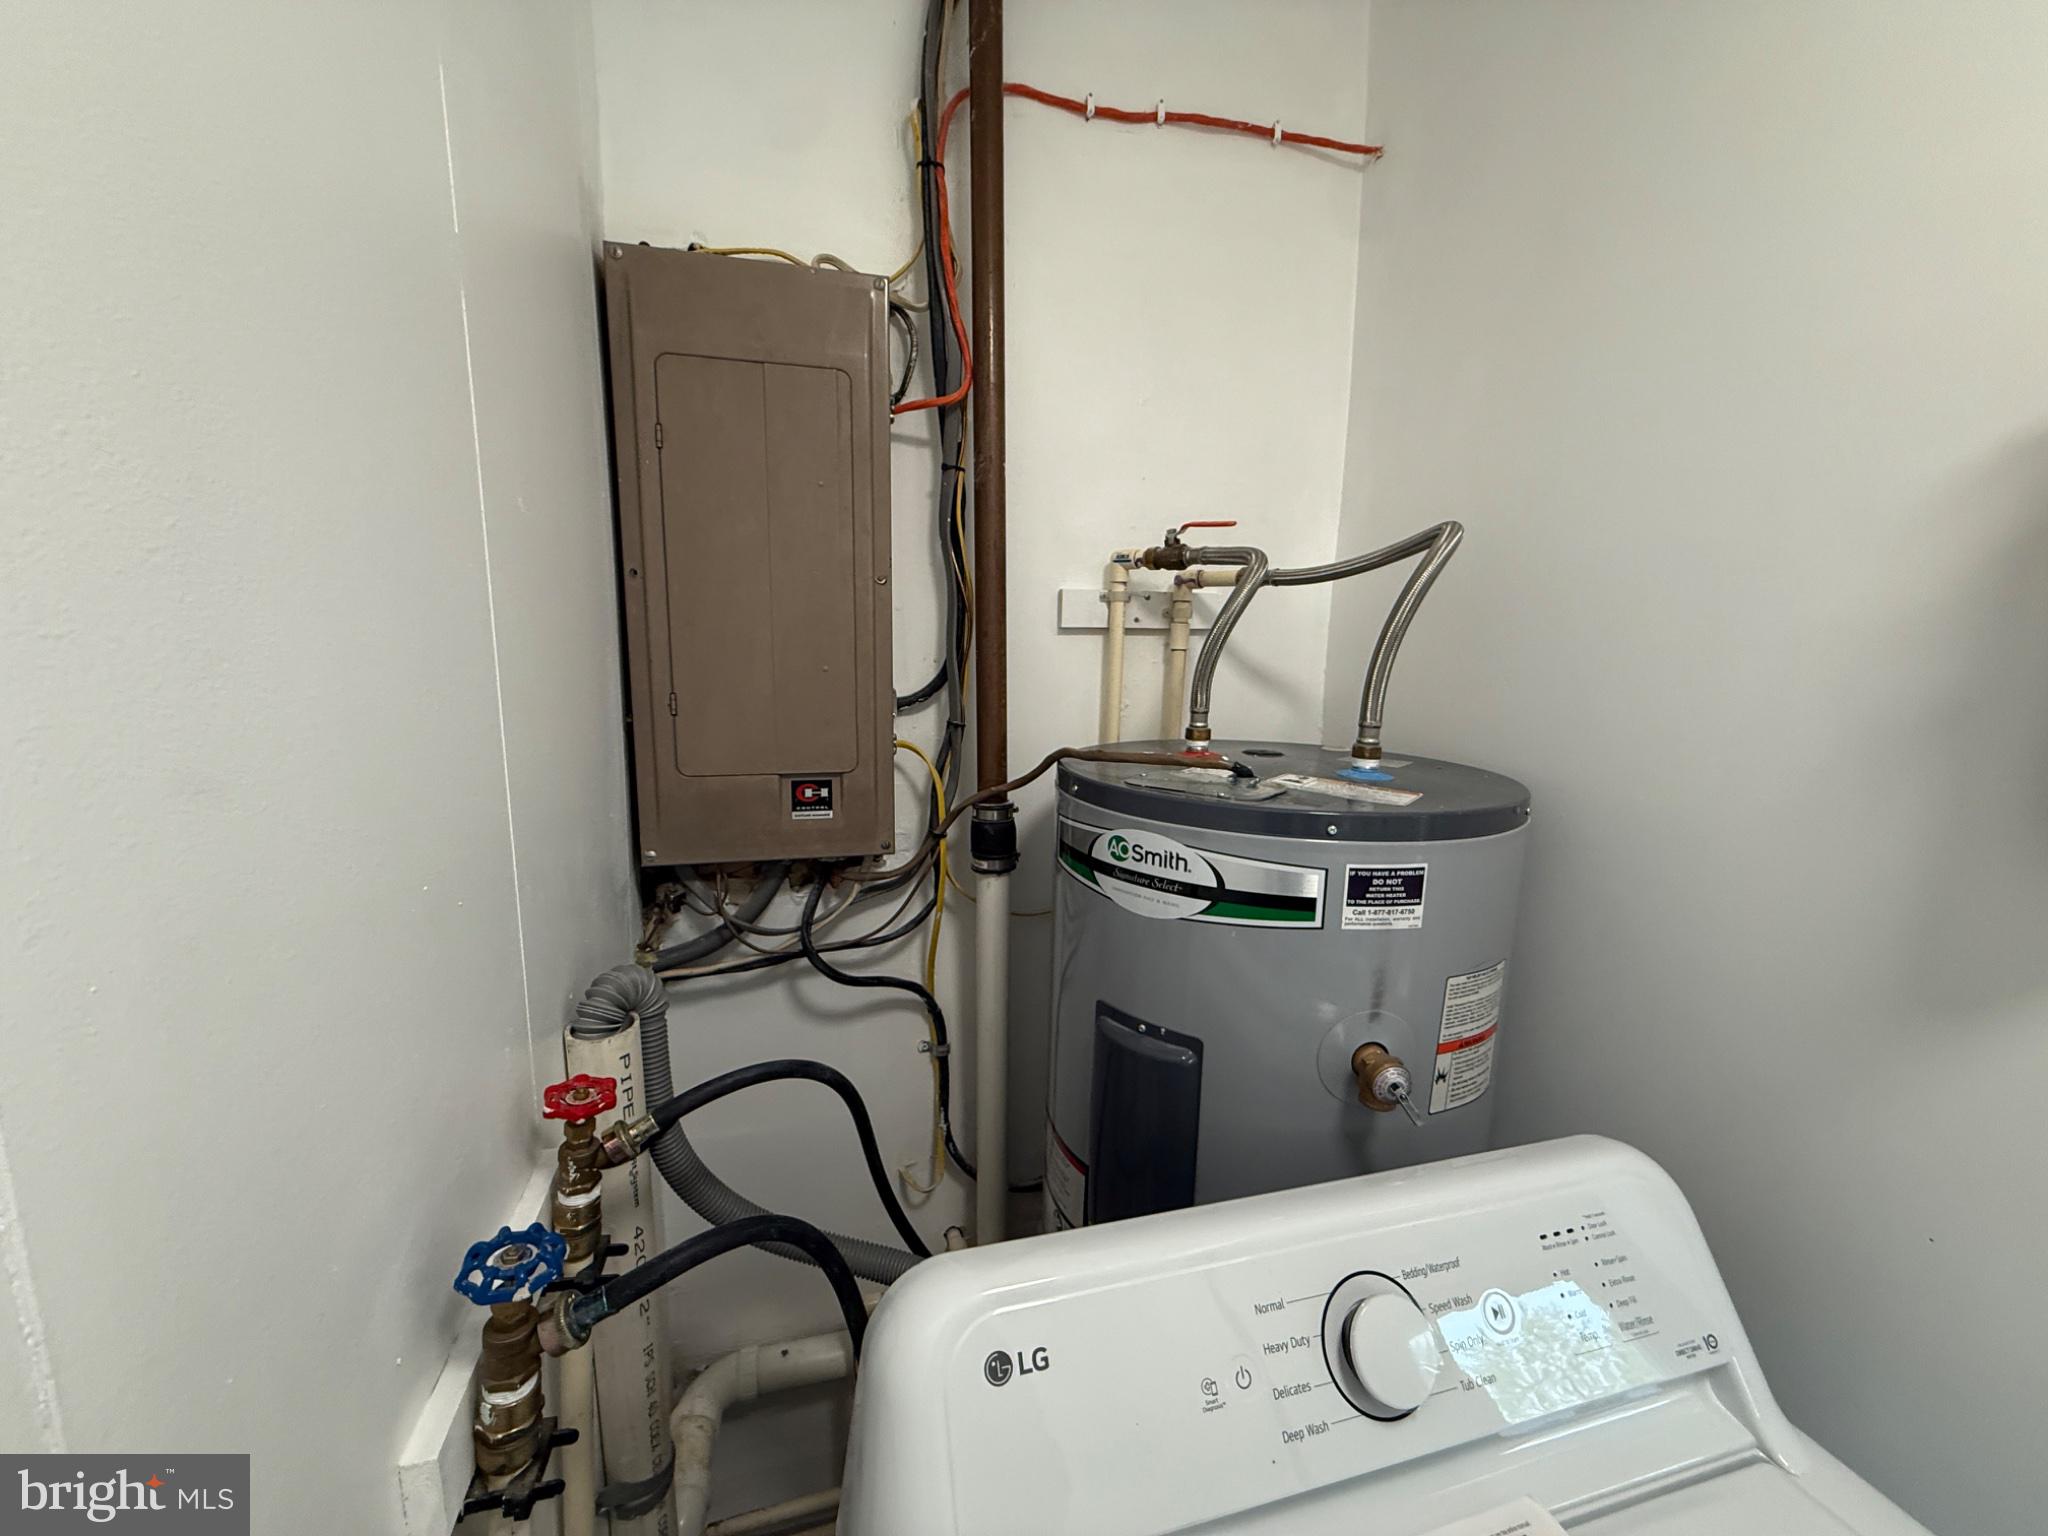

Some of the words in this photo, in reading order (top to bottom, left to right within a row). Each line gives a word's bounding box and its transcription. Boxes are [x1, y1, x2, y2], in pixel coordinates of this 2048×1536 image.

[619, 1052, 635, 1121] PIPE
[1400, 1256, 1461, 1280] Bedding/Waterproof
[1254, 1298, 1285, 1315] Normal
[1428, 1300, 1452, 1314] Speed
[1452, 1294, 1473, 1308] Wash
[1263, 1340, 1288, 1356] Heavy
[1290, 1334, 1311, 1350] Duty
[1449, 1340, 1467, 1353] Spin
[1467, 1335, 1484, 1348] Only
[1018, 1346, 1050, 1376] LG
[1272, 1382, 1312, 1401] Delicates
[1460, 1379, 1475, 1393] Tub
[1475, 1373, 1497, 1387] Clean
[1281, 1429, 1305, 1444] Deep
[1305, 1420, 1330, 1437] Wash
